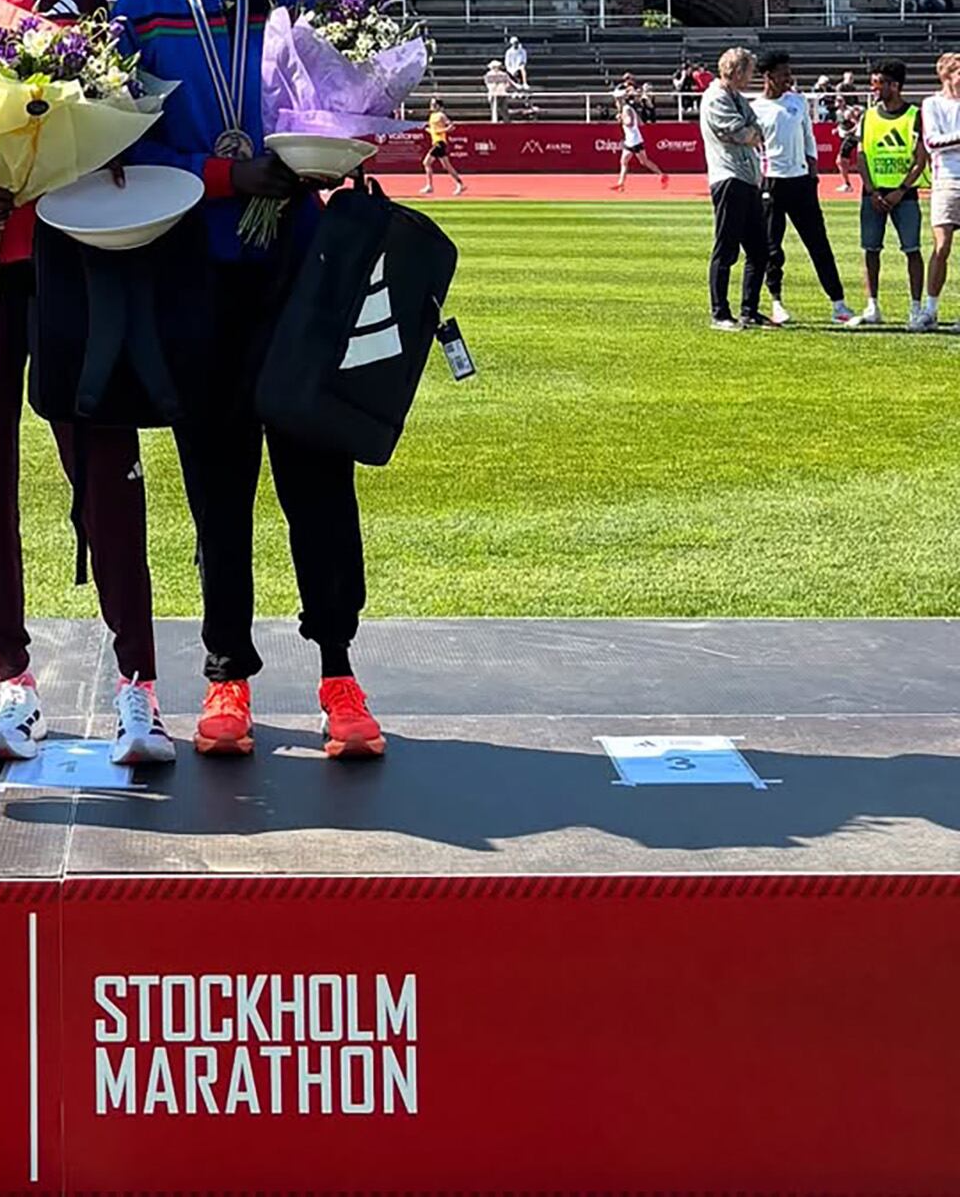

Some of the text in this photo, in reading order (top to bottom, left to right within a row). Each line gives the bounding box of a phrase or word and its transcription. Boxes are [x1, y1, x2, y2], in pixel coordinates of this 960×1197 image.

[665, 756, 697, 771] 3
[95, 974, 417, 1042] STOCKHOLM
[95, 1045, 418, 1114] MARATHON
